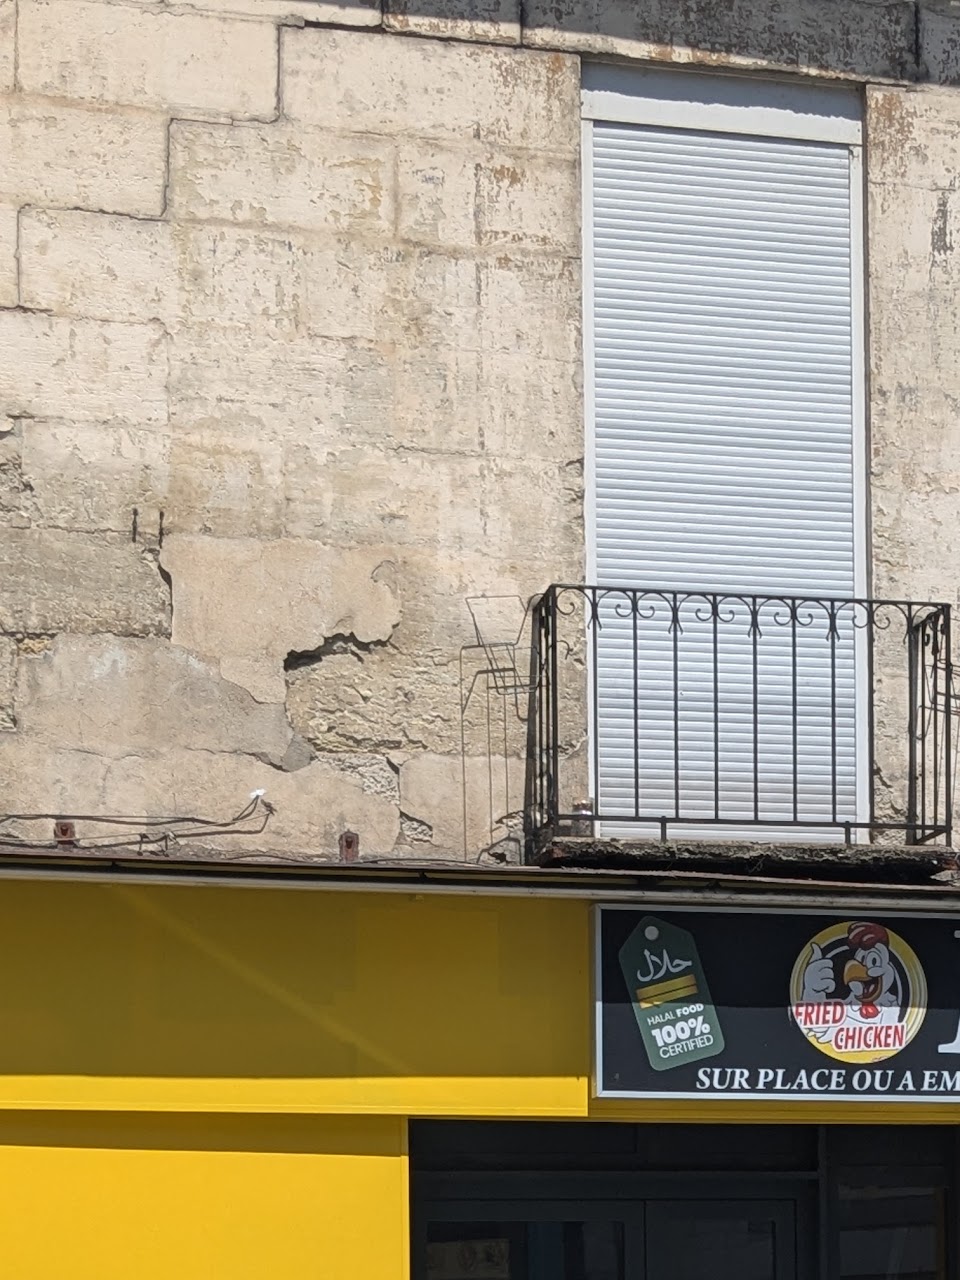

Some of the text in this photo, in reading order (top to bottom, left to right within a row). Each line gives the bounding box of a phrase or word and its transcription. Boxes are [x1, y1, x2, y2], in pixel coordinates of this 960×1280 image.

[637, 948, 692, 982] حلال
[647, 1003, 704, 1026] HALAL FOOD
[794, 1002, 845, 1027] FRIED
[651, 1016, 710, 1047] 100%
[833, 1023, 905, 1051] CHICKEN
[659, 1034, 714, 1060] CERTIFIED
[696, 1067, 750, 1090] SUR
[757, 1068, 846, 1091] PLACE
[852, 1069, 894, 1092] OU
[897, 1070, 915, 1092] A
